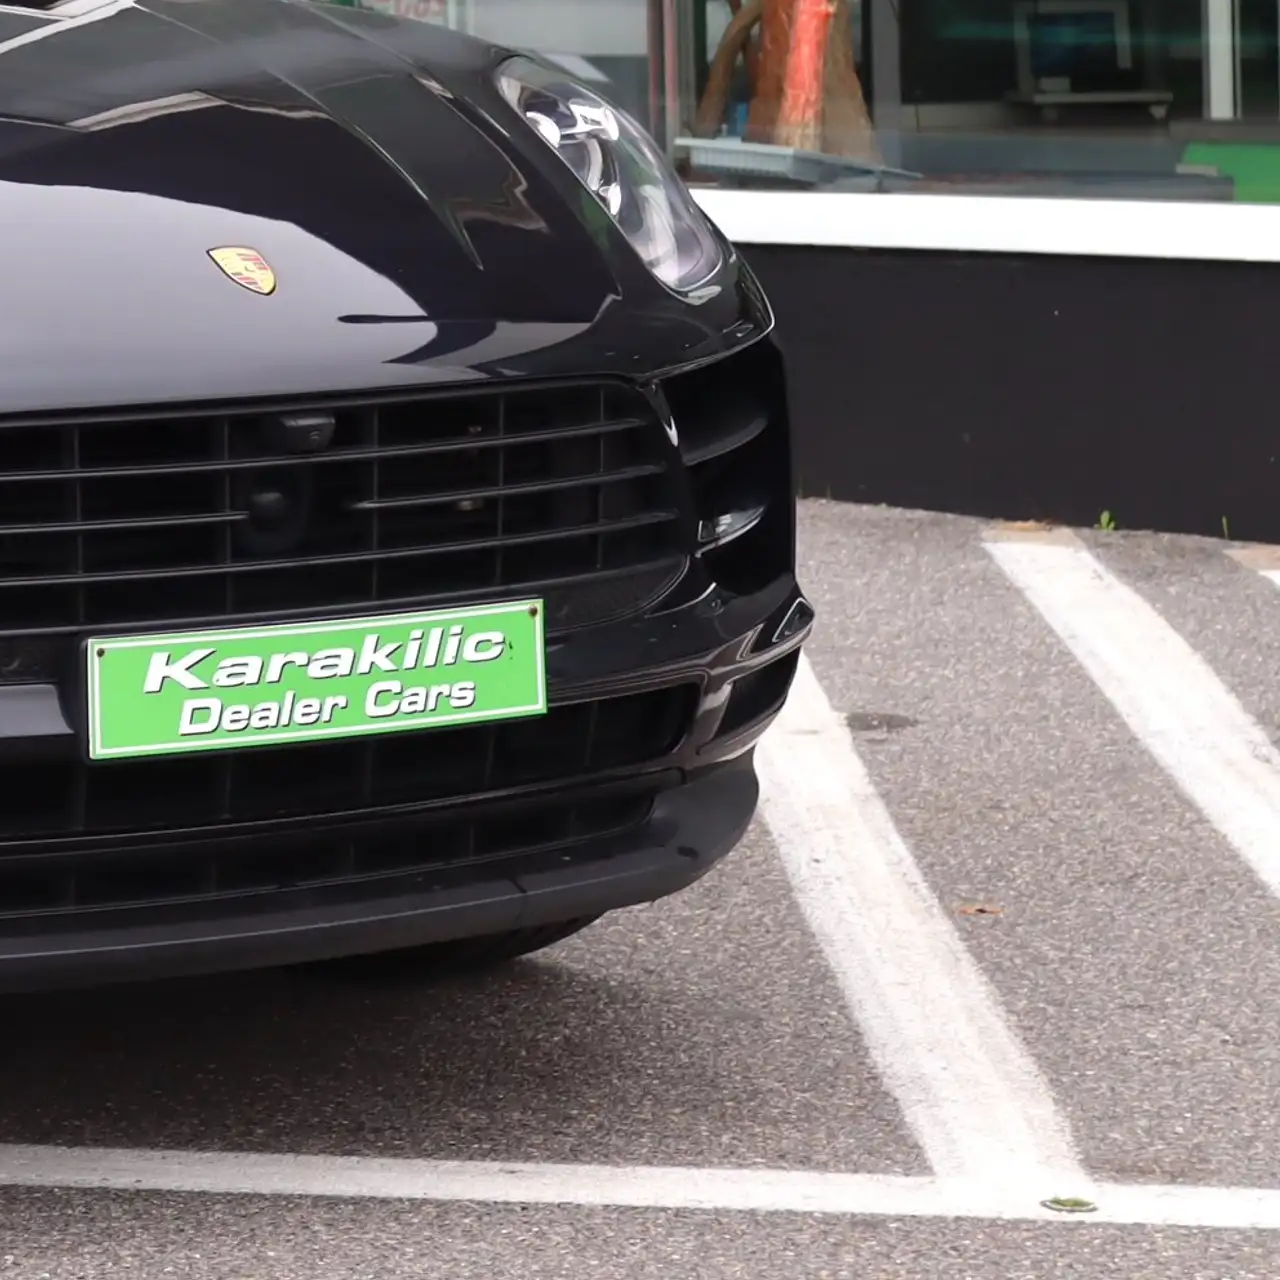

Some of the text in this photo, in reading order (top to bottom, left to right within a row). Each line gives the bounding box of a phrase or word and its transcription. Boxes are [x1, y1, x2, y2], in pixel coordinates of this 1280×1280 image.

[143, 624, 507, 693] Karakilic
[178, 679, 477, 736] Dealer Cars
